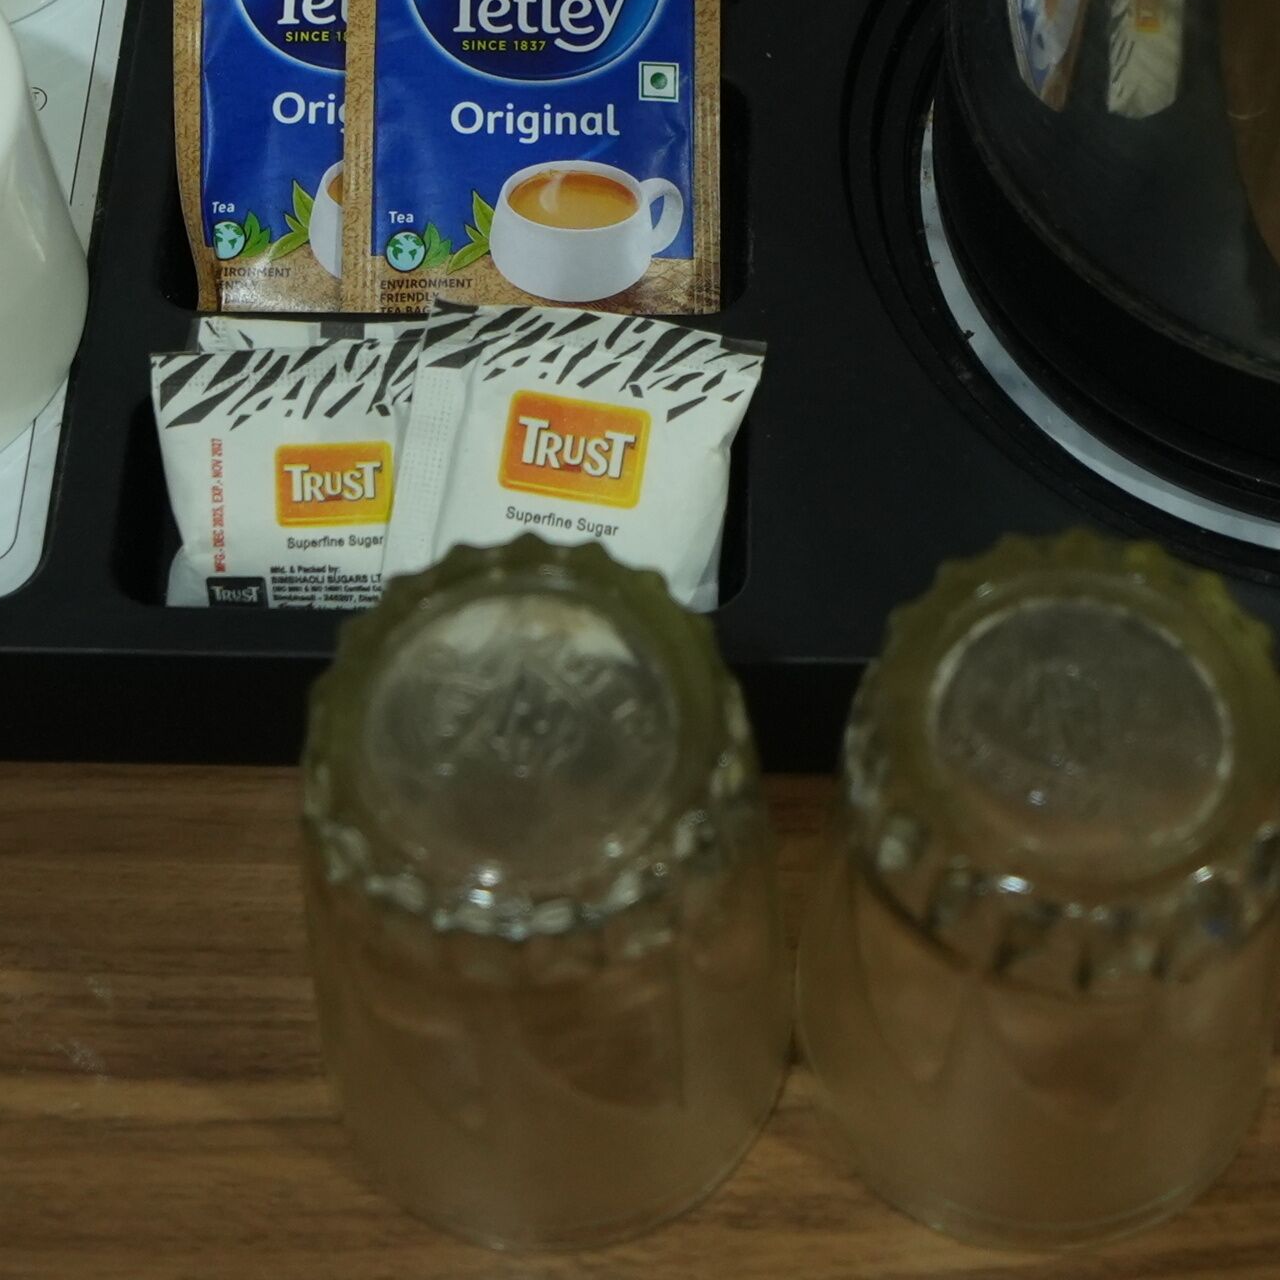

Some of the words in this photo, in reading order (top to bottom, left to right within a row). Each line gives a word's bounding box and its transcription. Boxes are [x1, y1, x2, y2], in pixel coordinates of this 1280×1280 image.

[285, 31, 329, 42] SINCE
[461, 40, 507, 51] SINCE
[514, 40, 547, 51] 1837
[272, 91, 347, 134] Ori
[450, 101, 620, 144] Original
[211, 201, 235, 213] Tea
[389, 211, 414, 224] Tea
[380, 278, 473, 290] ENVIRONMENT
[519, 416, 635, 479] TRUST
[284, 461, 382, 503] TRUST
[505, 506, 572, 529] Superfine
[576, 518, 618, 537] Sugar
[287, 536, 345, 549] Superfine
[348, 534, 384, 548] Sugar
[327, 575, 369, 583] SUGARS
[213, 586, 260, 602] TRUST
